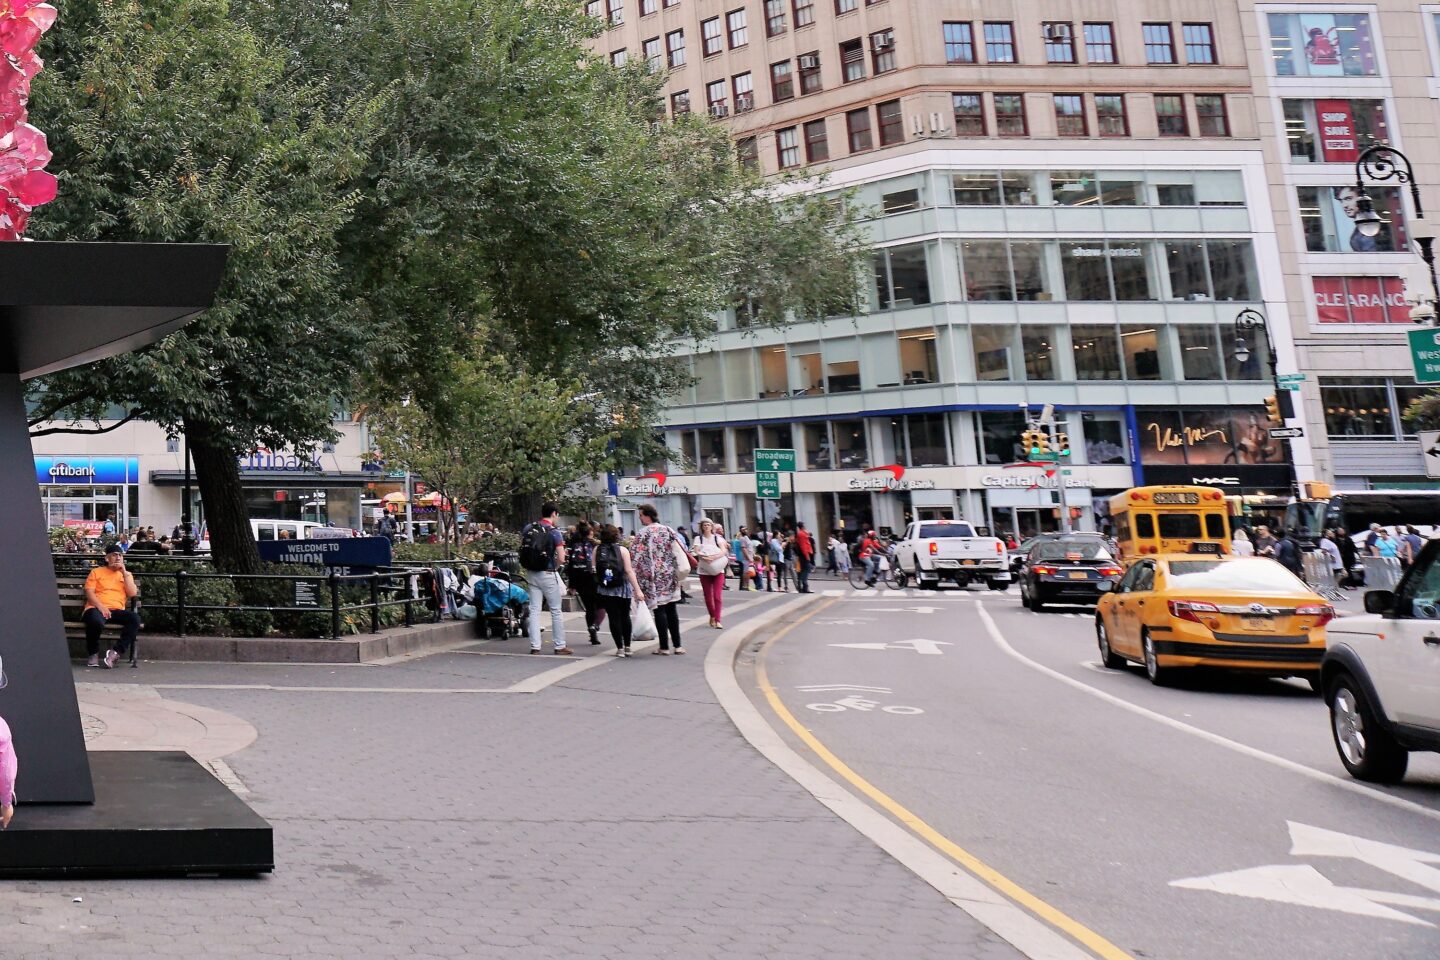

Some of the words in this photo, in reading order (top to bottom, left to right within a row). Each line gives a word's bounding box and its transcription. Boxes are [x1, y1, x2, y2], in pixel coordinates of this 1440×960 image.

[1324, 126, 1351, 136] SAVE
[1417, 350, 1440, 360] Wes
[756, 451, 794, 461] Broadway
[49, 463, 96, 476] citibank
[847, 477, 887, 490] Capital
[909, 480, 935, 490] Bank
[981, 474, 1032, 488] Capital
[1035, 474, 1058, 488] On
[1065, 478, 1096, 488] Bank
[623, 484, 652, 495] Capital
[668, 486, 689, 495] Bank
[287, 543, 327, 553] WELCOME
[328, 543, 340, 551] TO
